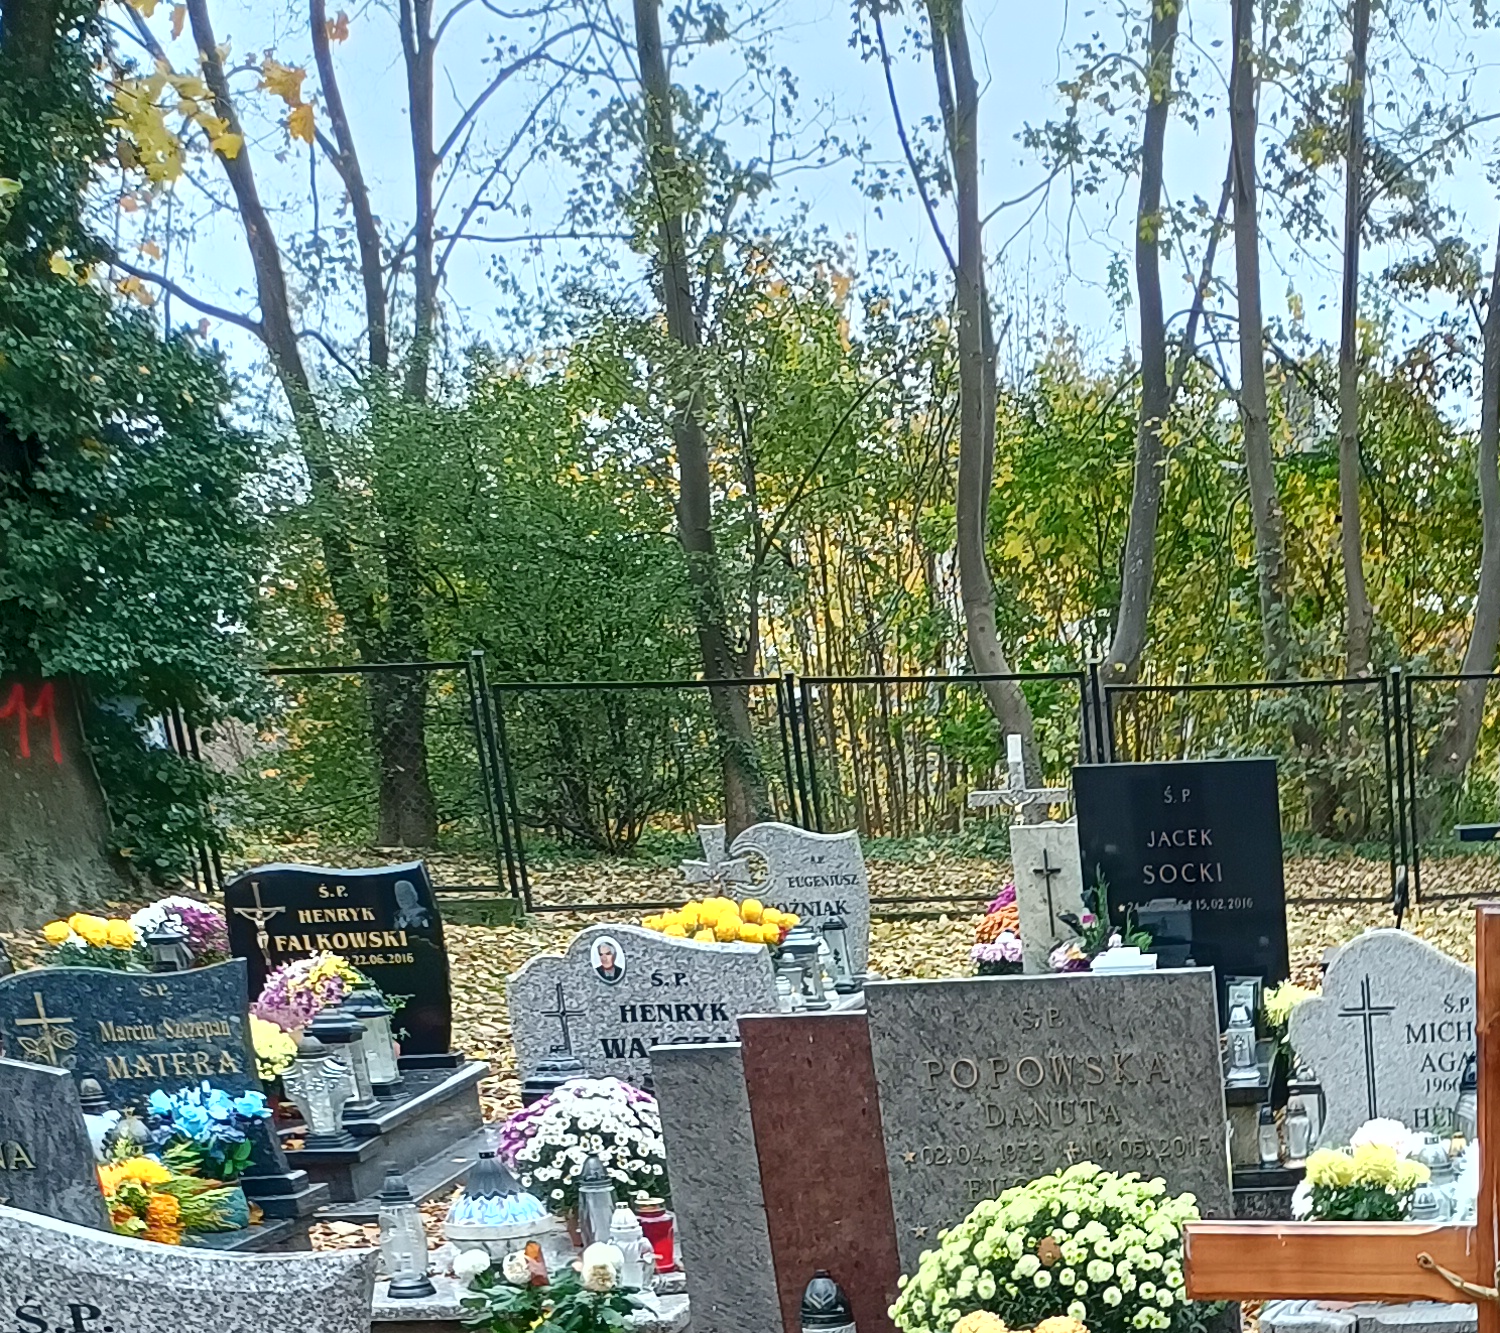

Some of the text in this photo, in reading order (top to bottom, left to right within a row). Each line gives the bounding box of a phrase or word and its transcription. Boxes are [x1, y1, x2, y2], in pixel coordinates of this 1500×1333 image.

[1147, 828, 1213, 848] JACEK
[786, 873, 860, 888] EUGENIUSZ
[1142, 862, 1223, 885] SOCKI
[297, 907, 376, 924] HENRYK
[764, 898, 851, 916] OŹNIAK
[273, 930, 408, 952] FALKOWSKI
[618, 1002, 729, 1024] HENRYK
[98, 1017, 232, 1043] Marcin Szczepan
[1405, 1020, 1473, 1044] MICH
[104, 1050, 243, 1080] MATERA
[921, 1051, 1171, 1091] POPOWSKA
[983, 1098, 1122, 1128] DANUTA
